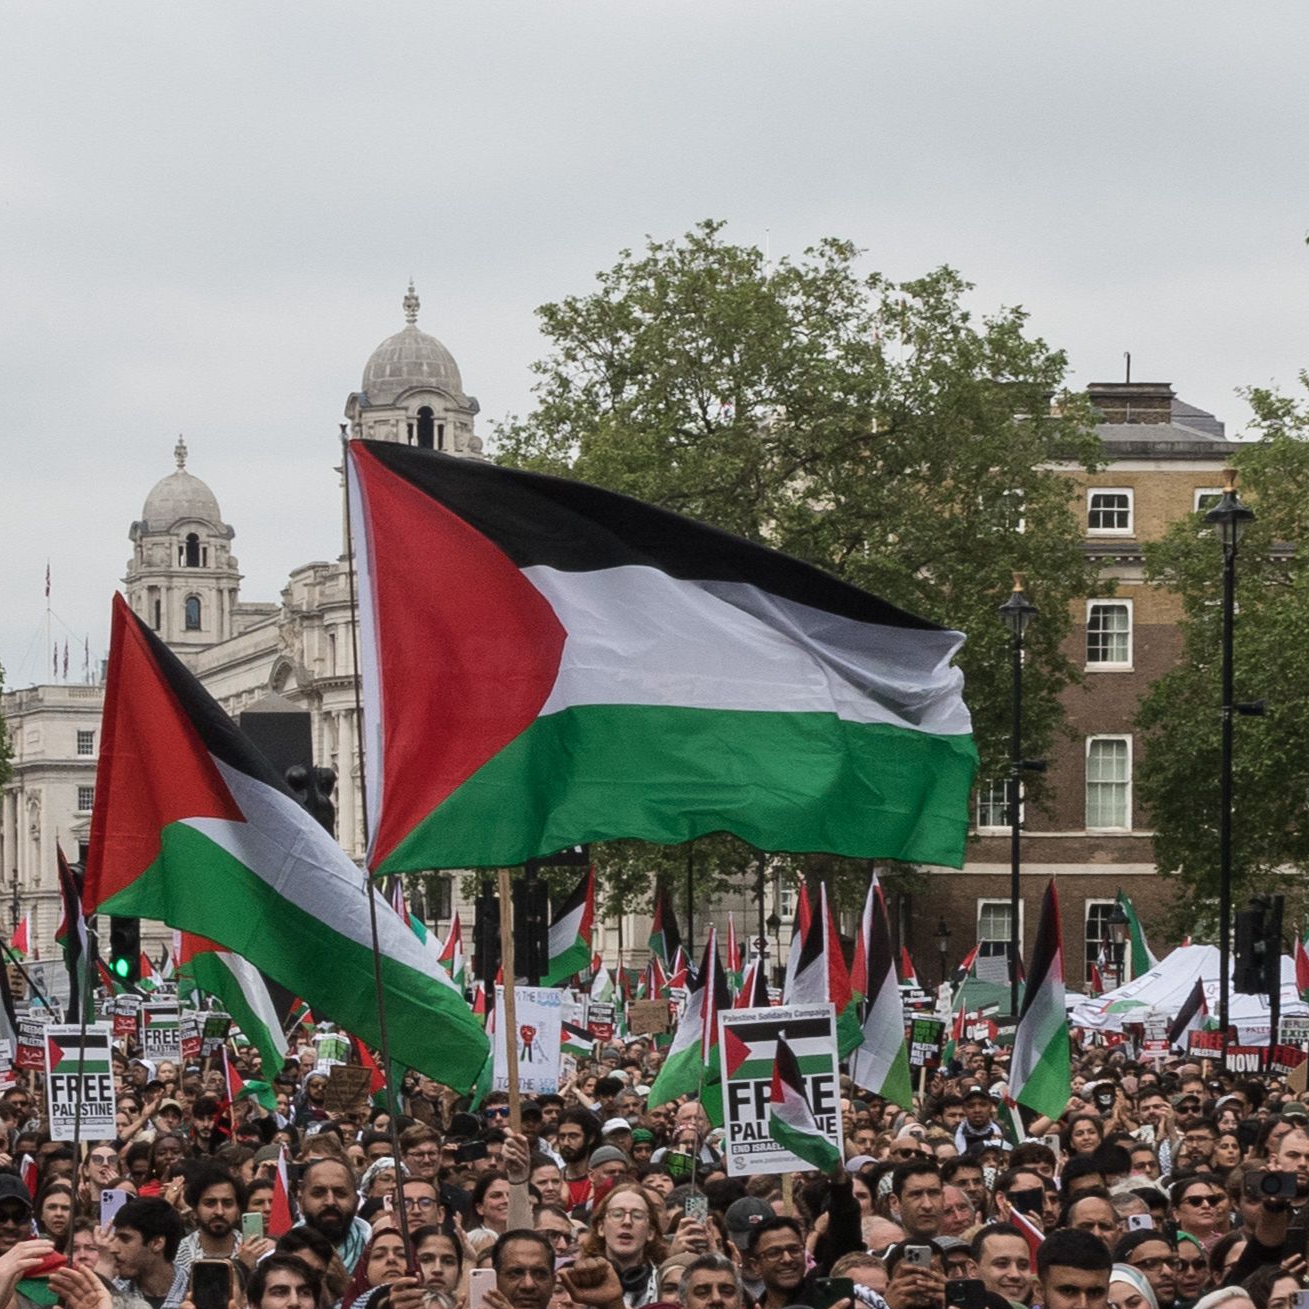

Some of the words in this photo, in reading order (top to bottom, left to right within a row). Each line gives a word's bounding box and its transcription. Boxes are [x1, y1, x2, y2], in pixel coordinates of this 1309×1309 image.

[723, 1013, 757, 1023] Palestine
[758, 1010, 793, 1021] Solidarity
[794, 1007, 831, 1019] Campaign
[145, 1028, 179, 1046] FREE
[1226, 1053, 1259, 1072] NOW
[728, 1074, 837, 1122] FRE
[52, 1102, 113, 1118] PALSTINE
[733, 1143, 752, 1154] END
